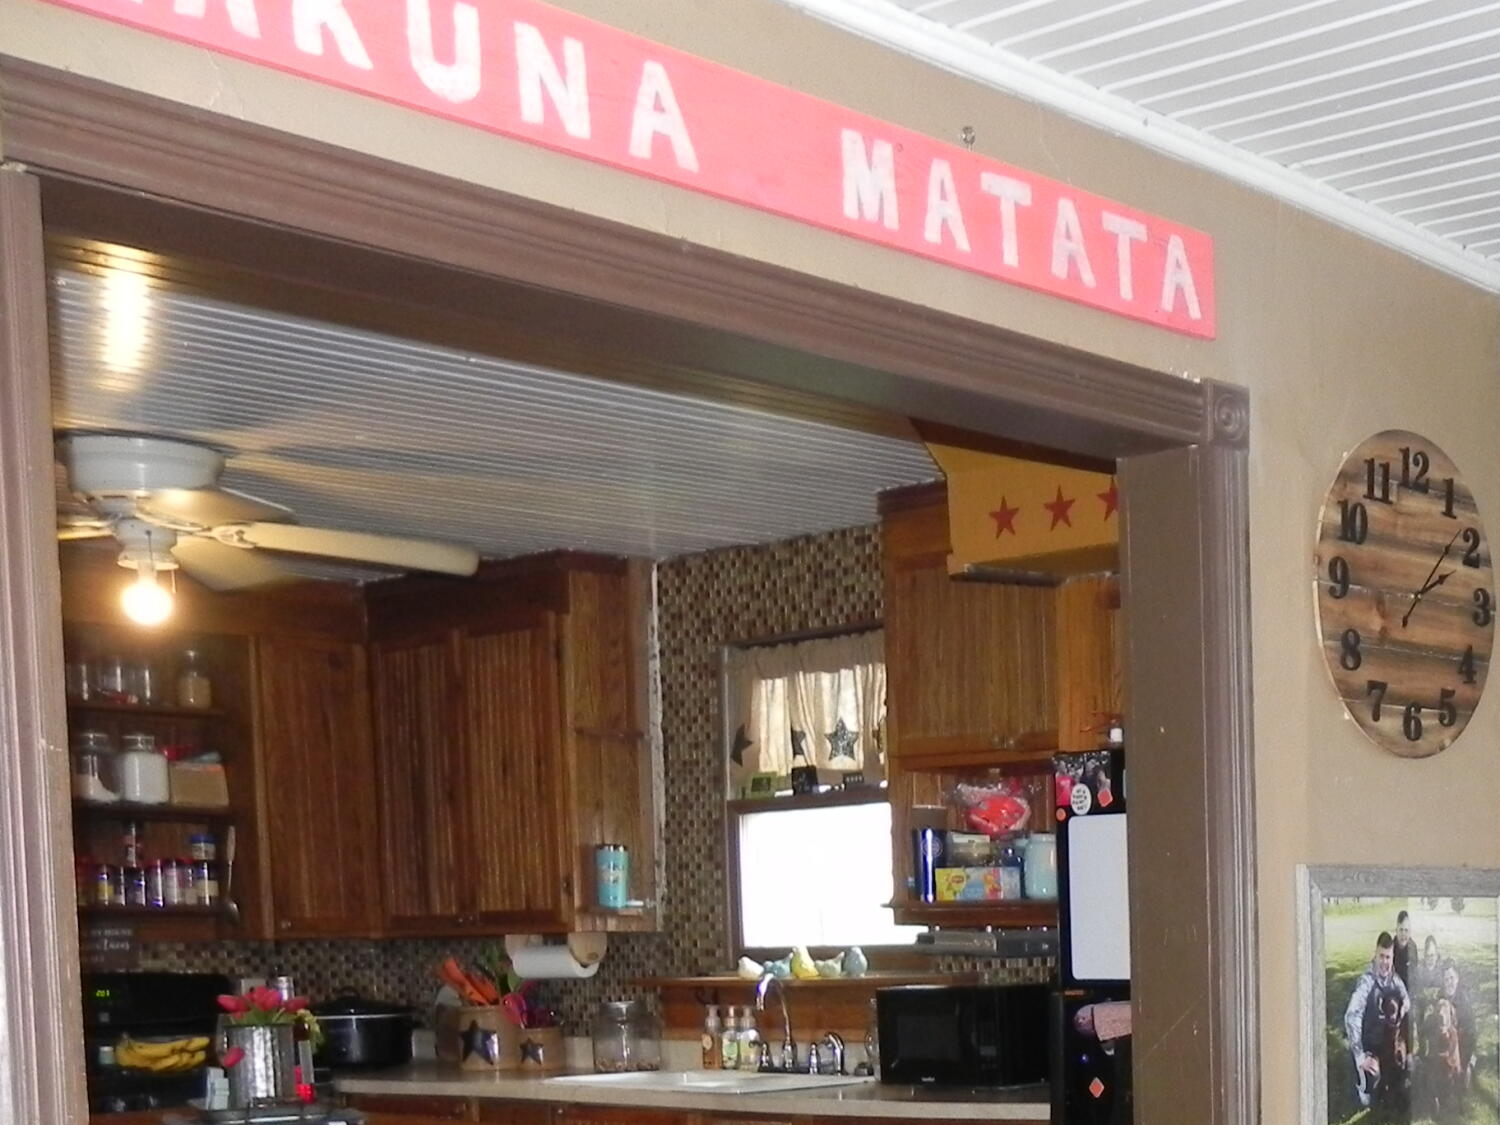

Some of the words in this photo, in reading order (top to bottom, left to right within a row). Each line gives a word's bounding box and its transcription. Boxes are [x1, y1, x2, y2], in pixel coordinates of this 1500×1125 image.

[126, 0, 699, 173] KUNA
[841, 128, 1201, 321] MATATA
[1363, 457, 1393, 505] 11
[1399, 446, 1430, 494] 12
[1441, 477, 1457, 519] 1
[1337, 499, 1368, 545] 10
[1462, 527, 1481, 569] 2
[1328, 556, 1350, 599] 9
[1472, 587, 1492, 627] 3
[1340, 628, 1362, 671] 8
[1457, 644, 1477, 685] 4
[1366, 679, 1388, 722] 7
[1403, 702, 1422, 742] 6
[1438, 688, 1457, 727] 5
